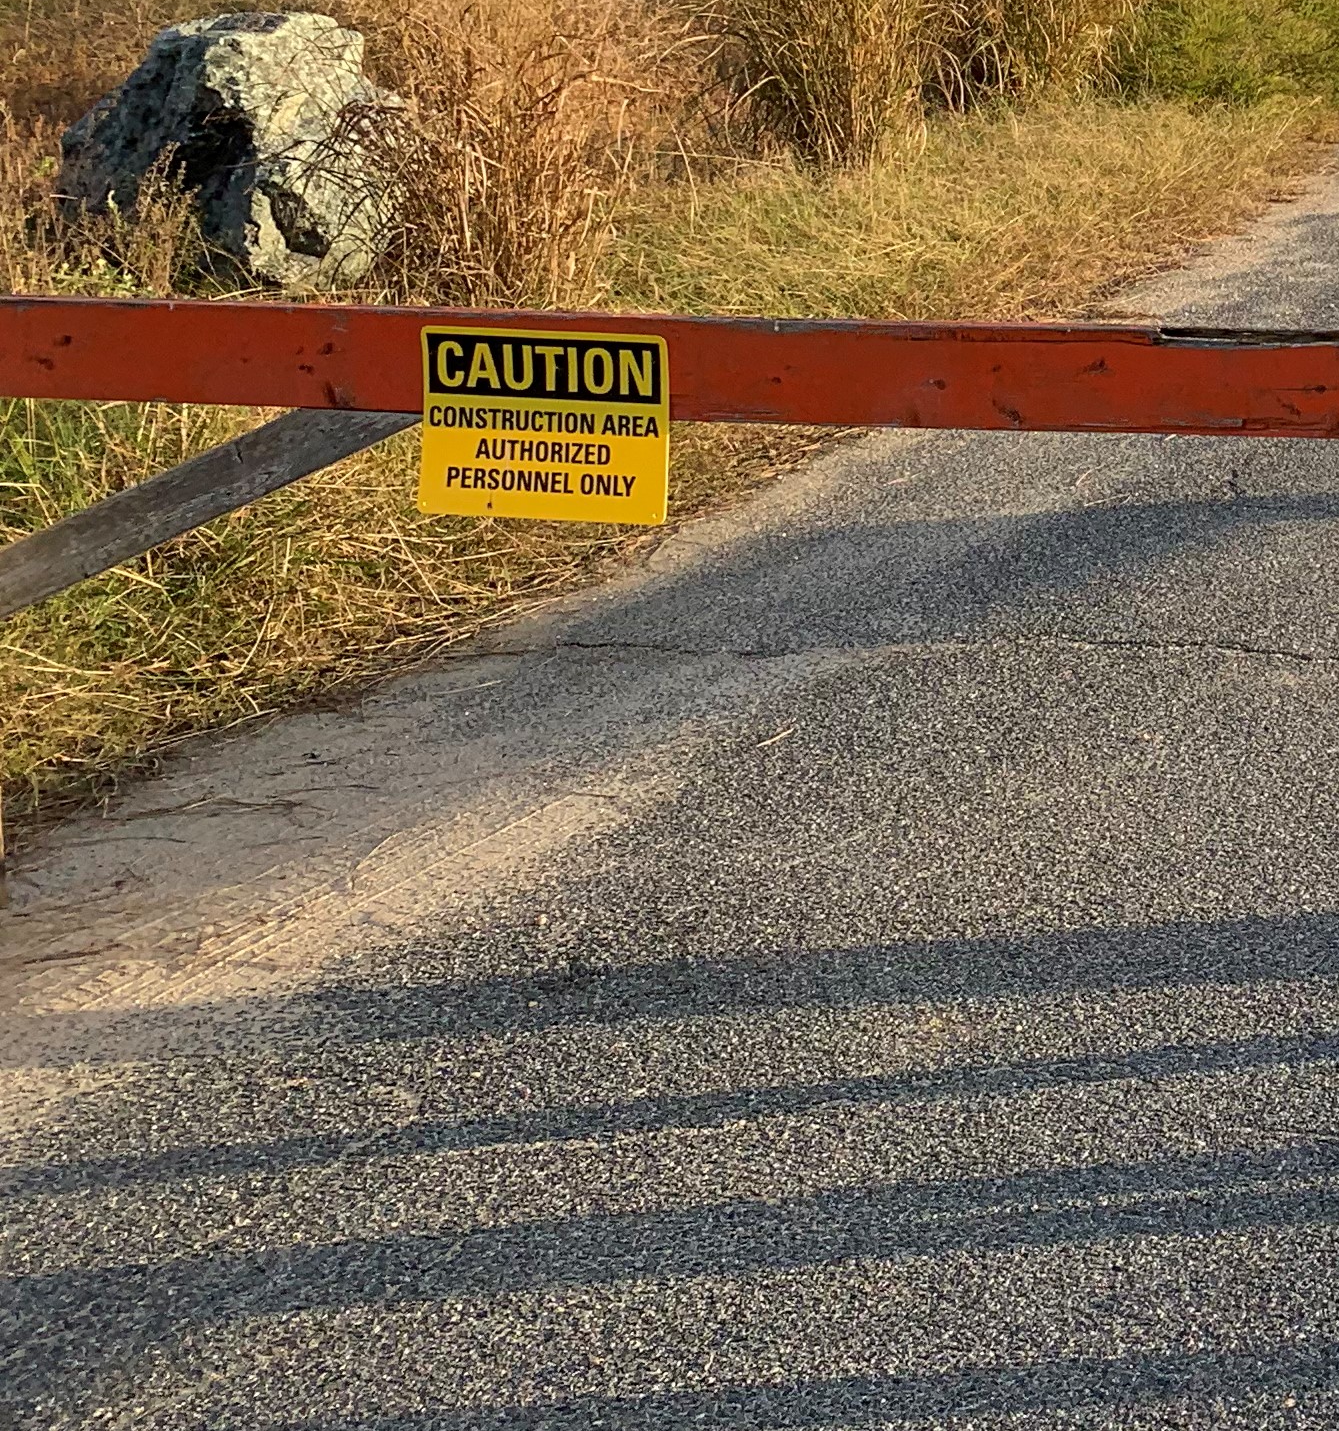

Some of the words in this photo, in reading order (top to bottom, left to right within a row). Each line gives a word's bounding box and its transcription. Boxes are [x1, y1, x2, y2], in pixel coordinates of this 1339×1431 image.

[437, 340, 653, 397] CAUTION
[429, 406, 595, 435] CONSTRUCTION
[602, 414, 659, 438] AREA
[475, 438, 610, 465] AUTHORIZED
[446, 466, 573, 494] PERSONNEL
[580, 474, 636, 497] ONLY
